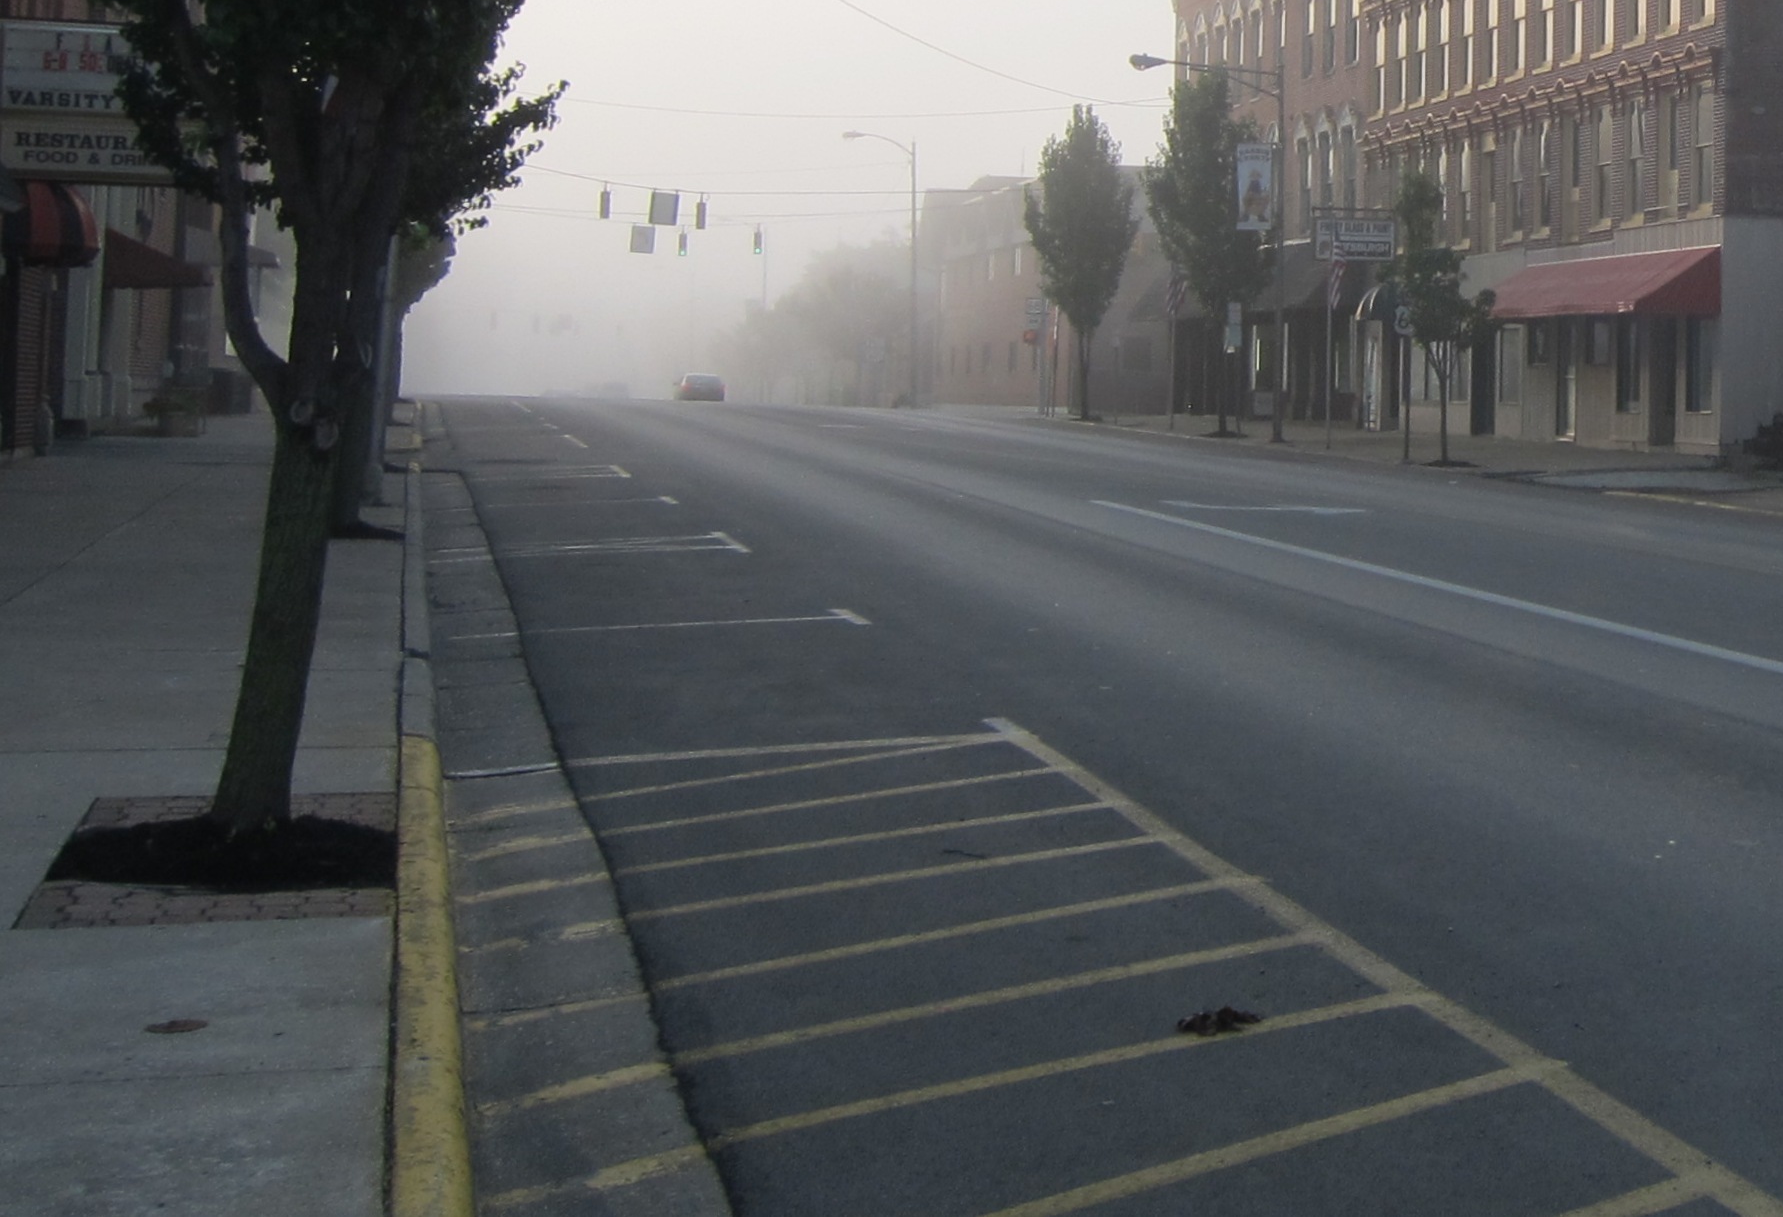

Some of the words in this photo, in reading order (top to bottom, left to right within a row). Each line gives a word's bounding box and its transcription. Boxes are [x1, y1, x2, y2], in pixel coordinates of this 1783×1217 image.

[8, 90, 115, 109] VARSITY
[23, 150, 79, 163] FOOD
[87, 153, 100, 164] &
